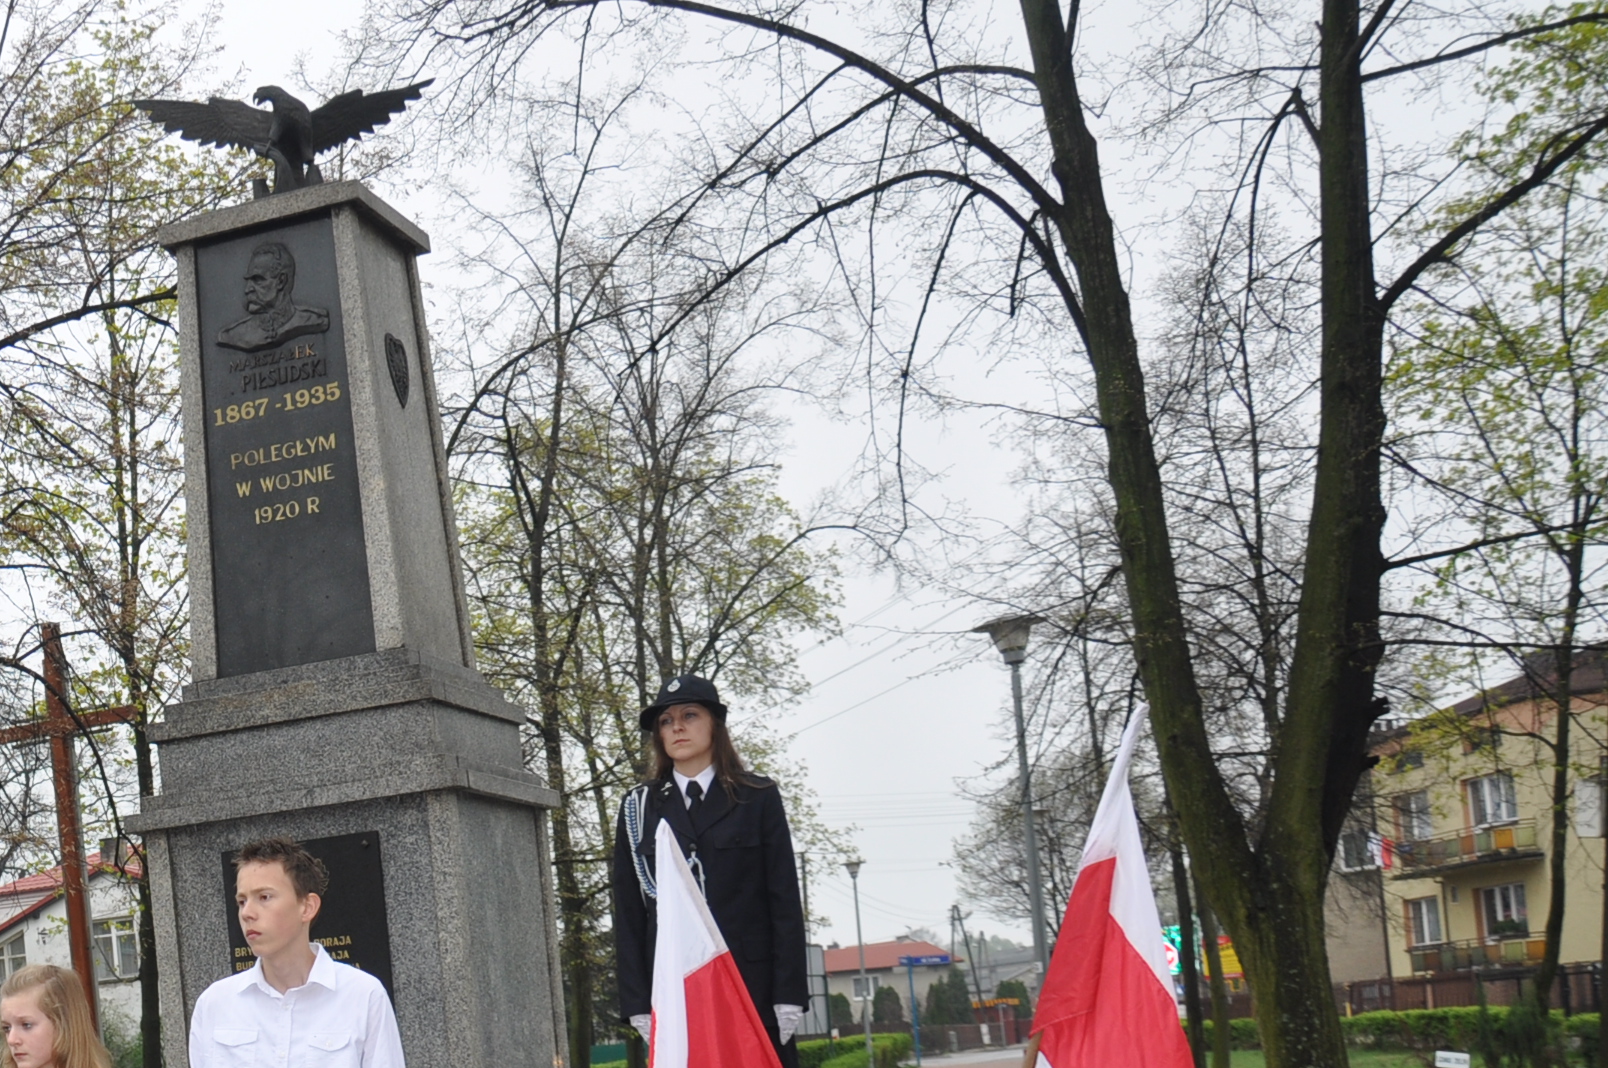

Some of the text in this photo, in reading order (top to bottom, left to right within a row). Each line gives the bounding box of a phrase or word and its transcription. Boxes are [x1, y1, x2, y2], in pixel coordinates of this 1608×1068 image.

[242, 359, 328, 393] PIŁSUDSKI
[213, 397, 269, 426] 1867
[230, 432, 336, 470] POLEGŁYM
[235, 463, 335, 498] W WOJNIE
[254, 496, 320, 525] 1920 R
